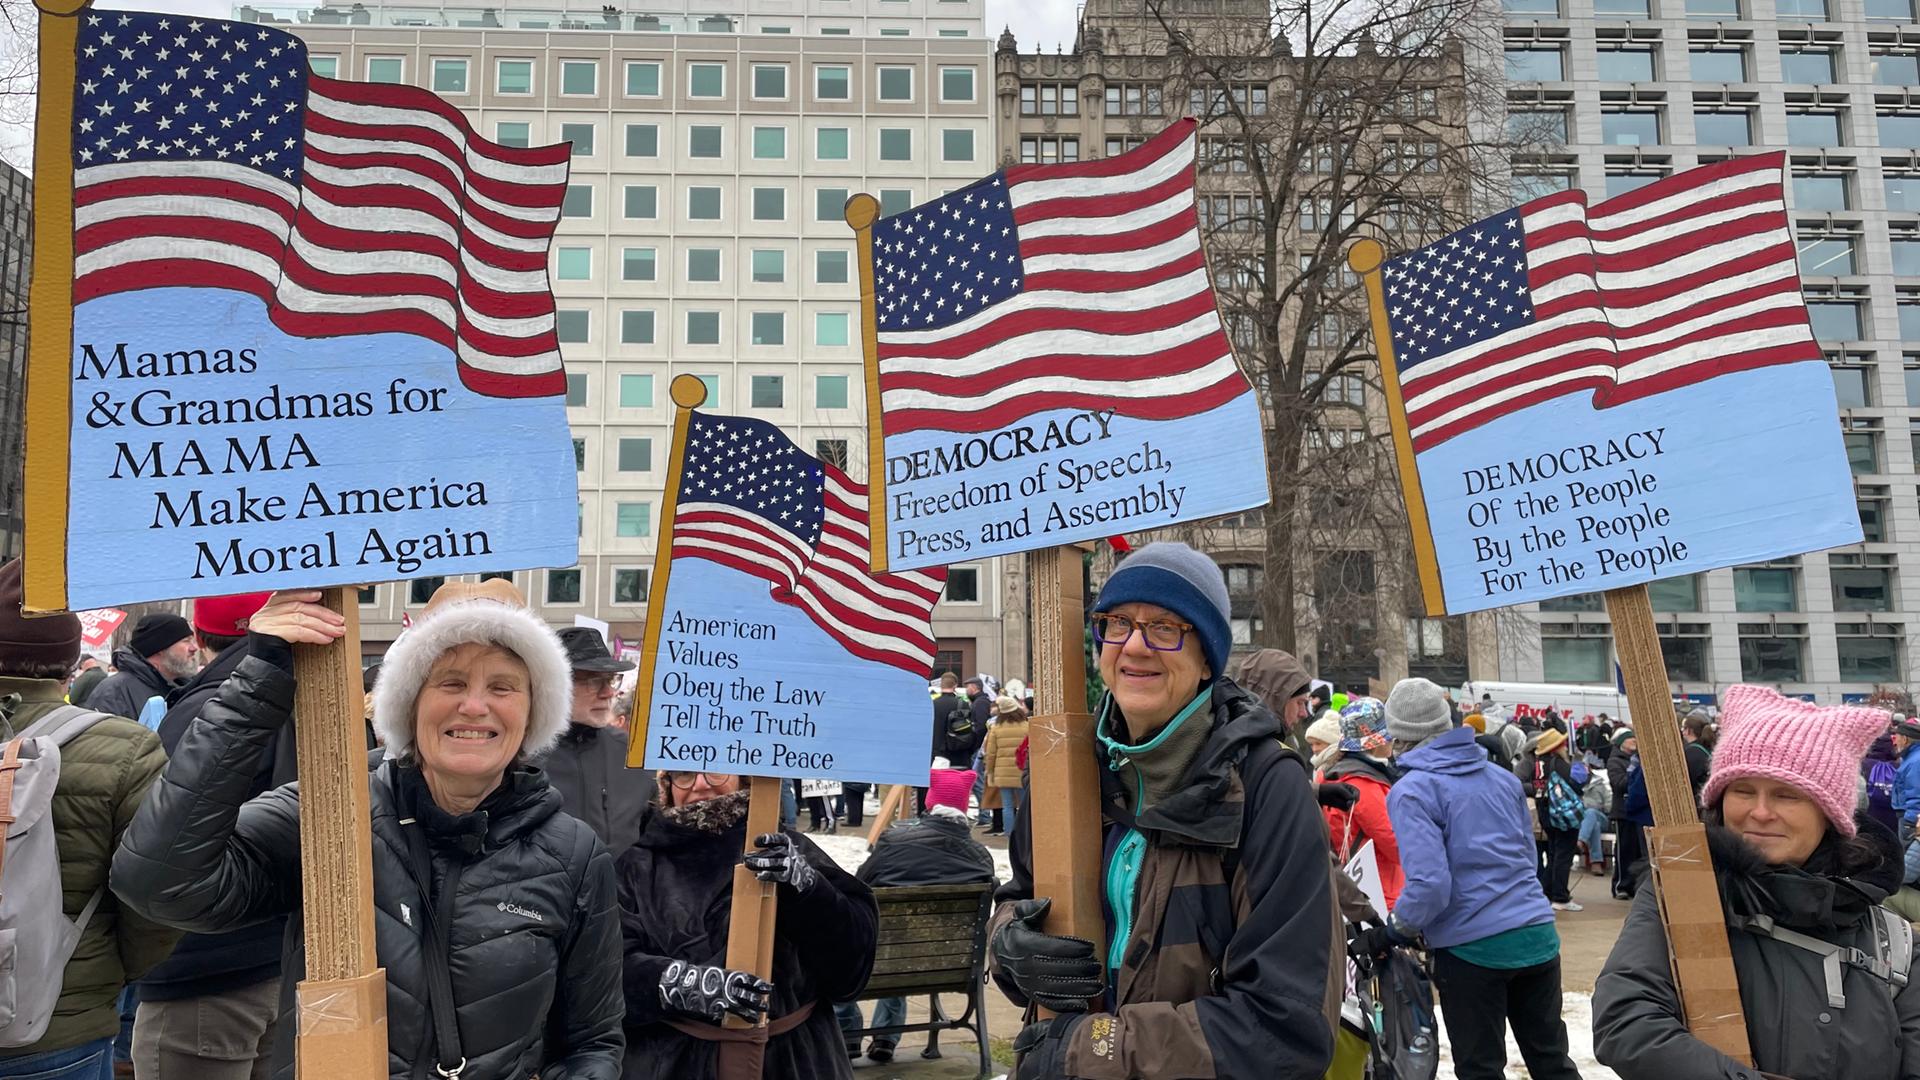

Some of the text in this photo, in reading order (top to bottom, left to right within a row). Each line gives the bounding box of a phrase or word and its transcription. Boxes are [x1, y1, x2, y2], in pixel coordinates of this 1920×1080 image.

[75, 344, 256, 380] Mamas
[86, 378, 447, 428] &Grandmas for
[109, 433, 320, 478] MAMA
[887, 407, 1117, 486] DEMOCRACY
[1463, 428, 1664, 495] DEMOCRACY
[150, 478, 488, 528] Make America
[893, 442, 1171, 521] Freedom of Speech,
[1468, 469, 1656, 527] Of the People
[898, 480, 1186, 558] Press, and Assembly
[1473, 503, 1669, 567] By the People
[191, 528, 492, 578] Moral Again
[1481, 536, 1687, 595] For the People
[668, 611, 775, 640] American
[668, 641, 738, 669] Values
[663, 672, 825, 706] Obey the Law
[661, 705, 815, 737] Tell the Truth
[658, 736, 833, 770] Keep the Peace
[506, 904, 543, 921] Columbia
